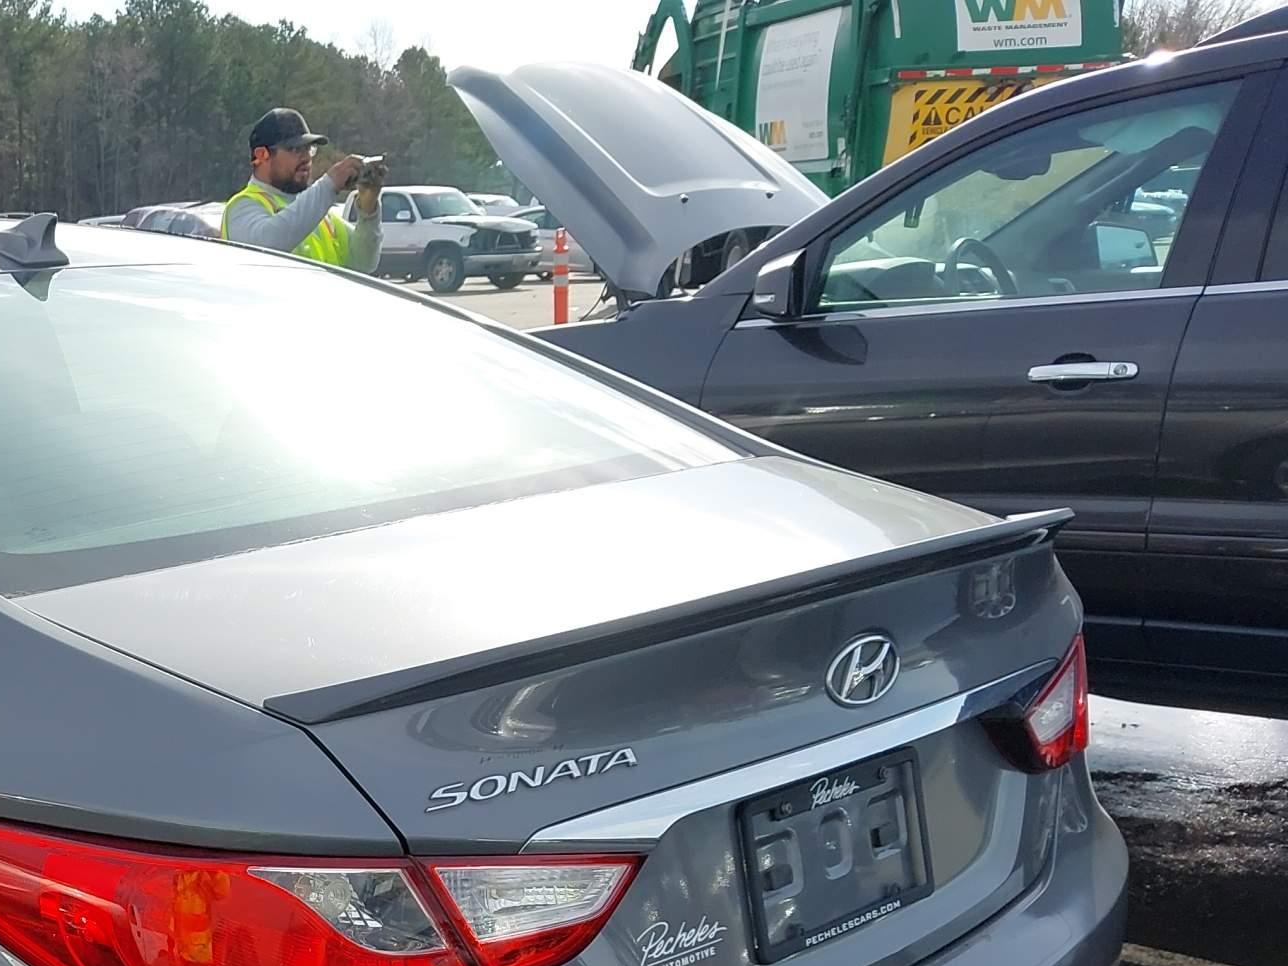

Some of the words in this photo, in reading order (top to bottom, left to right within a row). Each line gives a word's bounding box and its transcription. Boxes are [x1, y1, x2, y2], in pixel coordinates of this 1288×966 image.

[972, 24, 1002, 32] WASTE
[1005, 21, 1068, 31] MANAGEMENT
[993, 35, 1048, 48] wm.com
[945, 105, 984, 125] CA
[425, 747, 638, 812] SONATA
[810, 776, 861, 810] Pecheles
[636, 915, 728, 966] Pecheles
[805, 900, 901, 947] PECHELESCARS.COM
